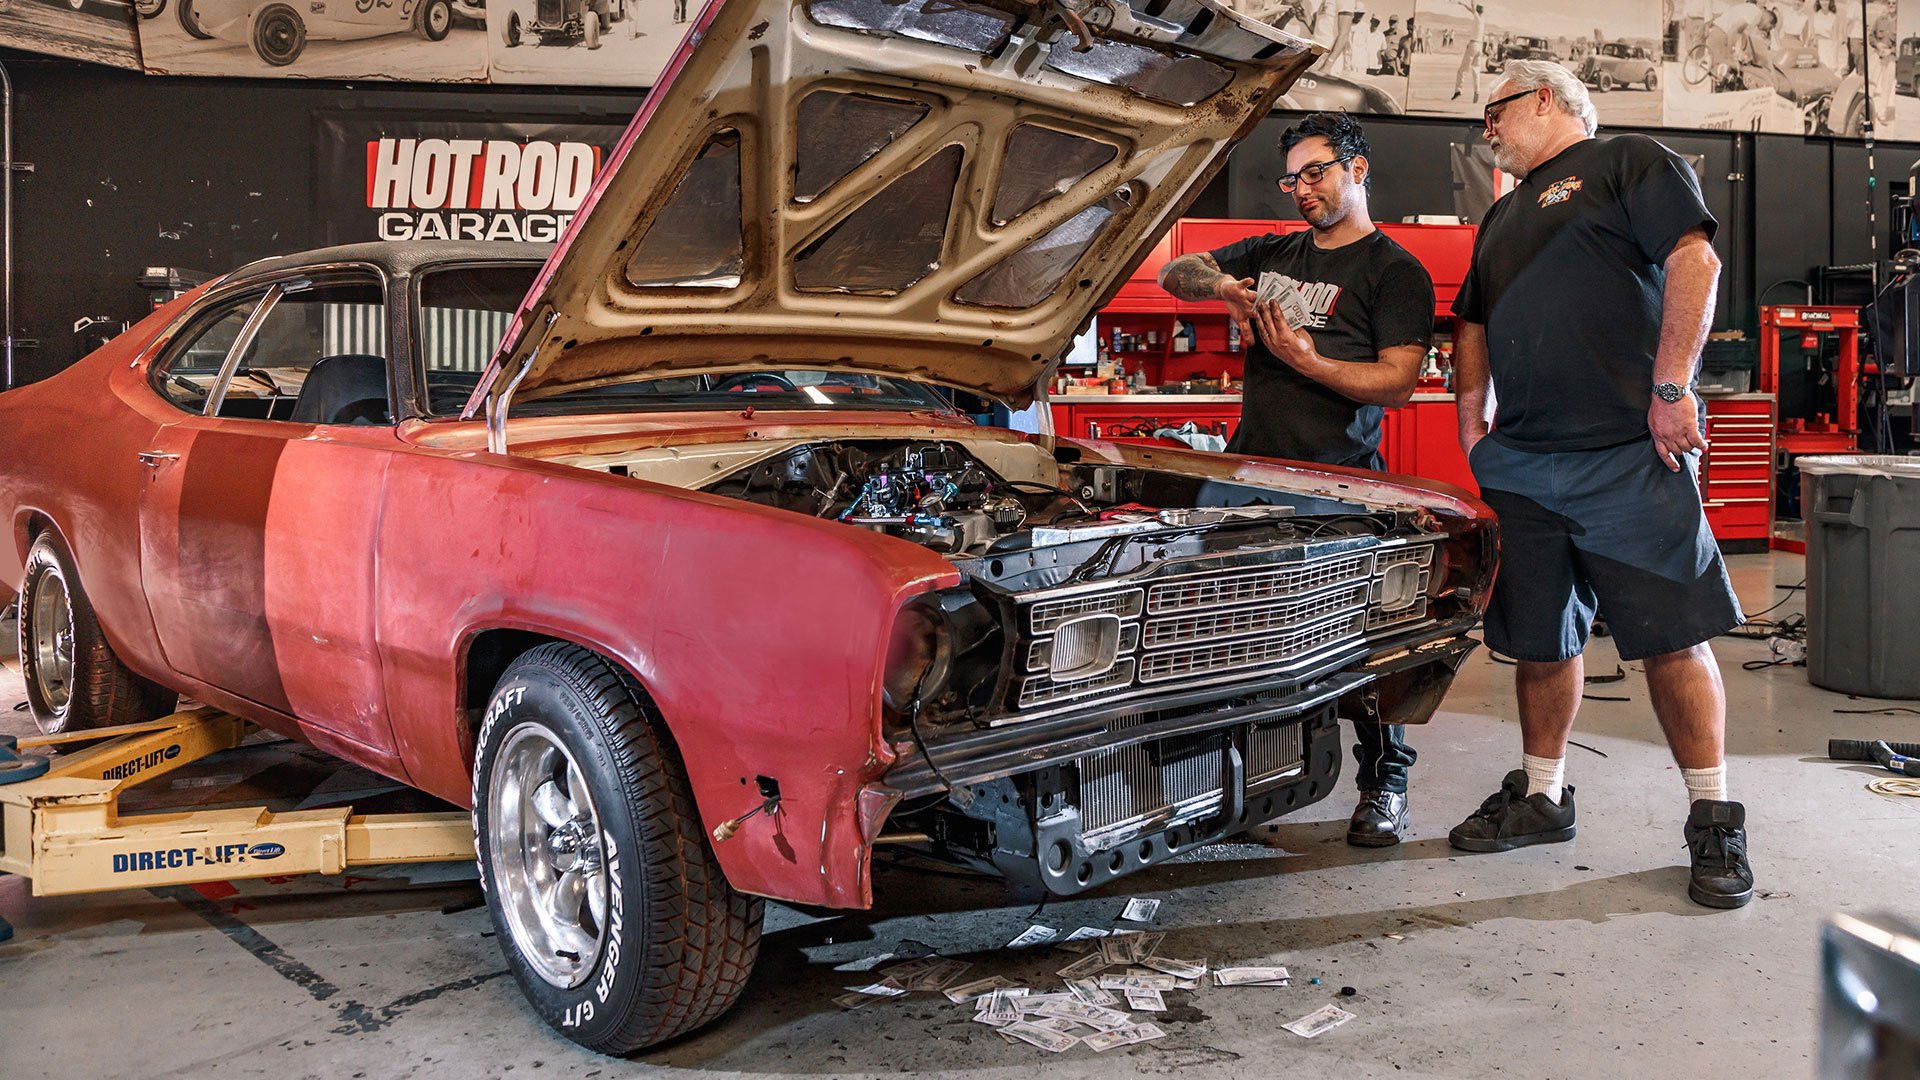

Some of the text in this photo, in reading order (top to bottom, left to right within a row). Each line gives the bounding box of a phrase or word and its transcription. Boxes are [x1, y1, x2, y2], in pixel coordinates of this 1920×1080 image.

[372, 138, 594, 211] HOT ROD
[102, 747, 166, 781] DIRECT-LIFT
[472, 686, 527, 893] MASTERCRAFT
[113, 843, 249, 873] DIRECT-LIFT
[562, 829, 625, 1028] AVENGER G/T
